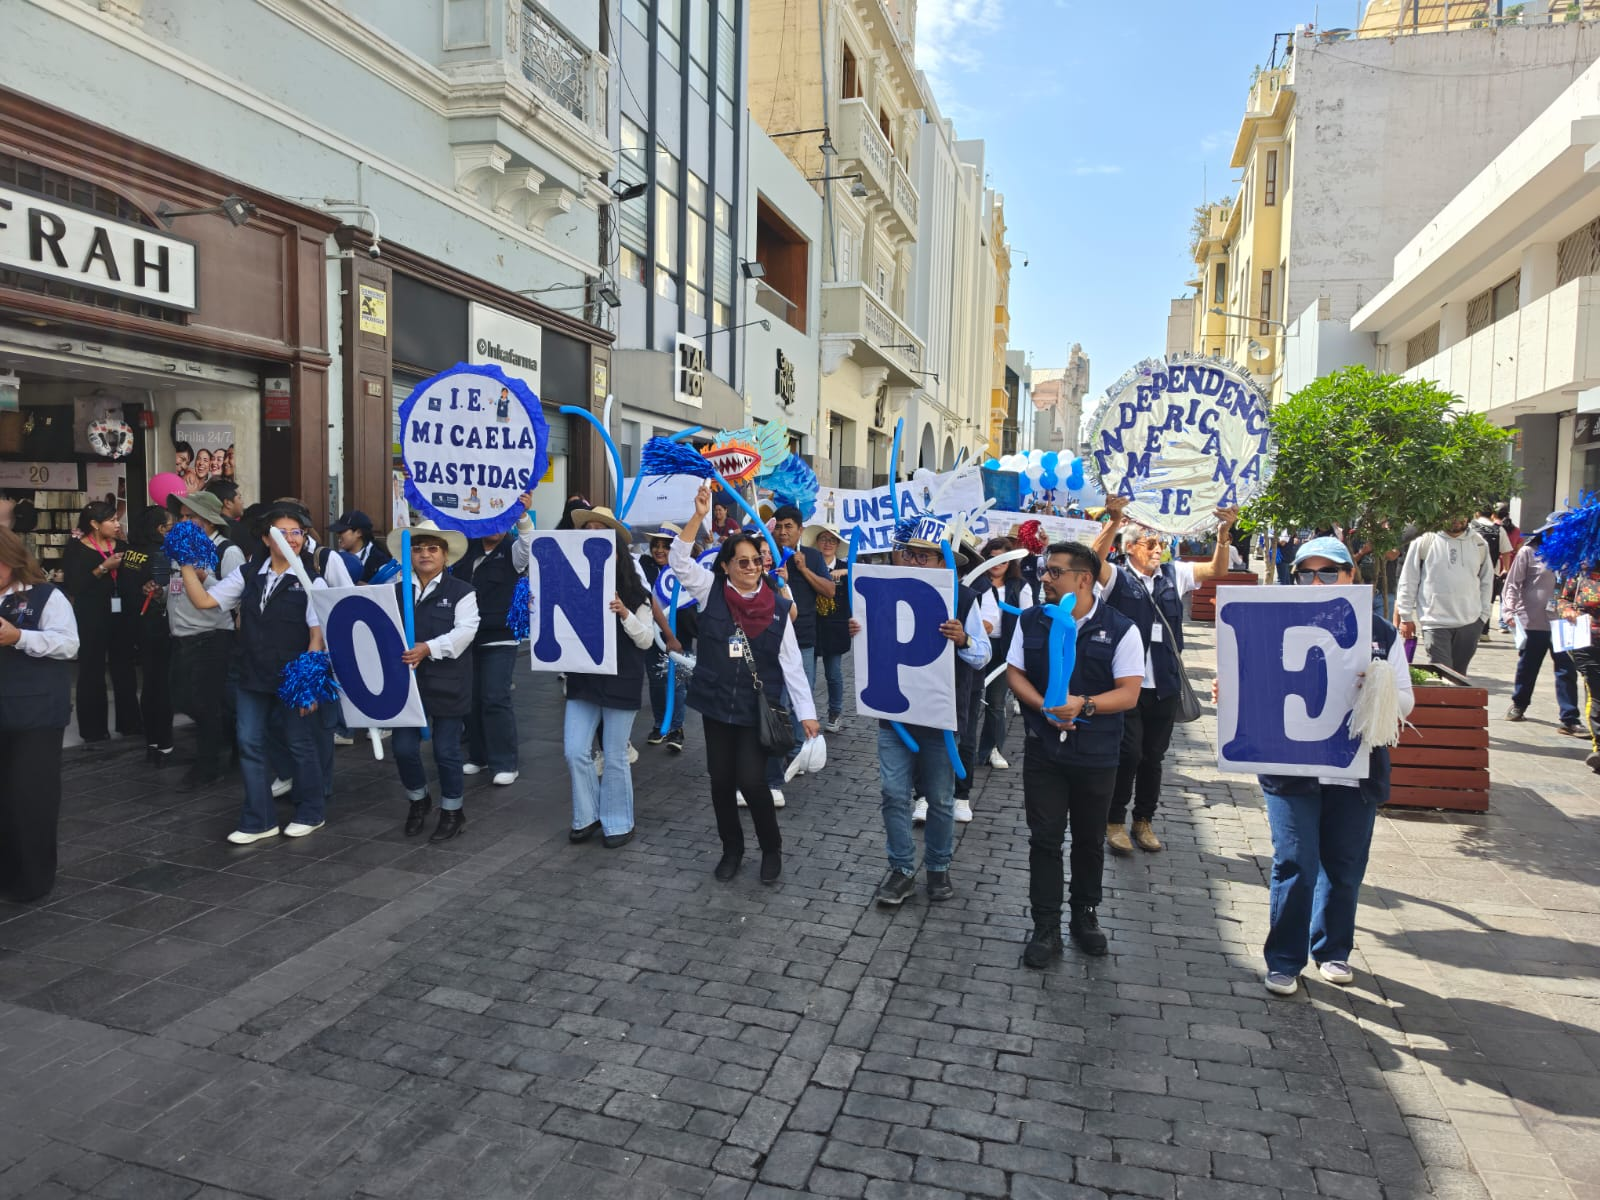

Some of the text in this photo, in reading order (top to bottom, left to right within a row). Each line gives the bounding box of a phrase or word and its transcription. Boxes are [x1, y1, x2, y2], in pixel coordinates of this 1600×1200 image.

[487, 340, 538, 371] Inkafarma
[176, 430, 205, 443] Brilla
[411, 420, 534, 449] MICAELA
[1093, 365, 1270, 481] INDEPENDENCIA
[1117, 398, 1238, 508] AMERICANA
[29, 466, 49, 483] 20
[413, 460, 530, 490] BASTIDAS
[842, 490, 920, 523] UNSA
[1158, 488, 1193, 516] IE
[914, 517, 946, 544] NPE
[531, 536, 613, 666] N
[326, 595, 410, 721] O
[854, 576, 949, 714] P
[1220, 597, 1361, 768] E
